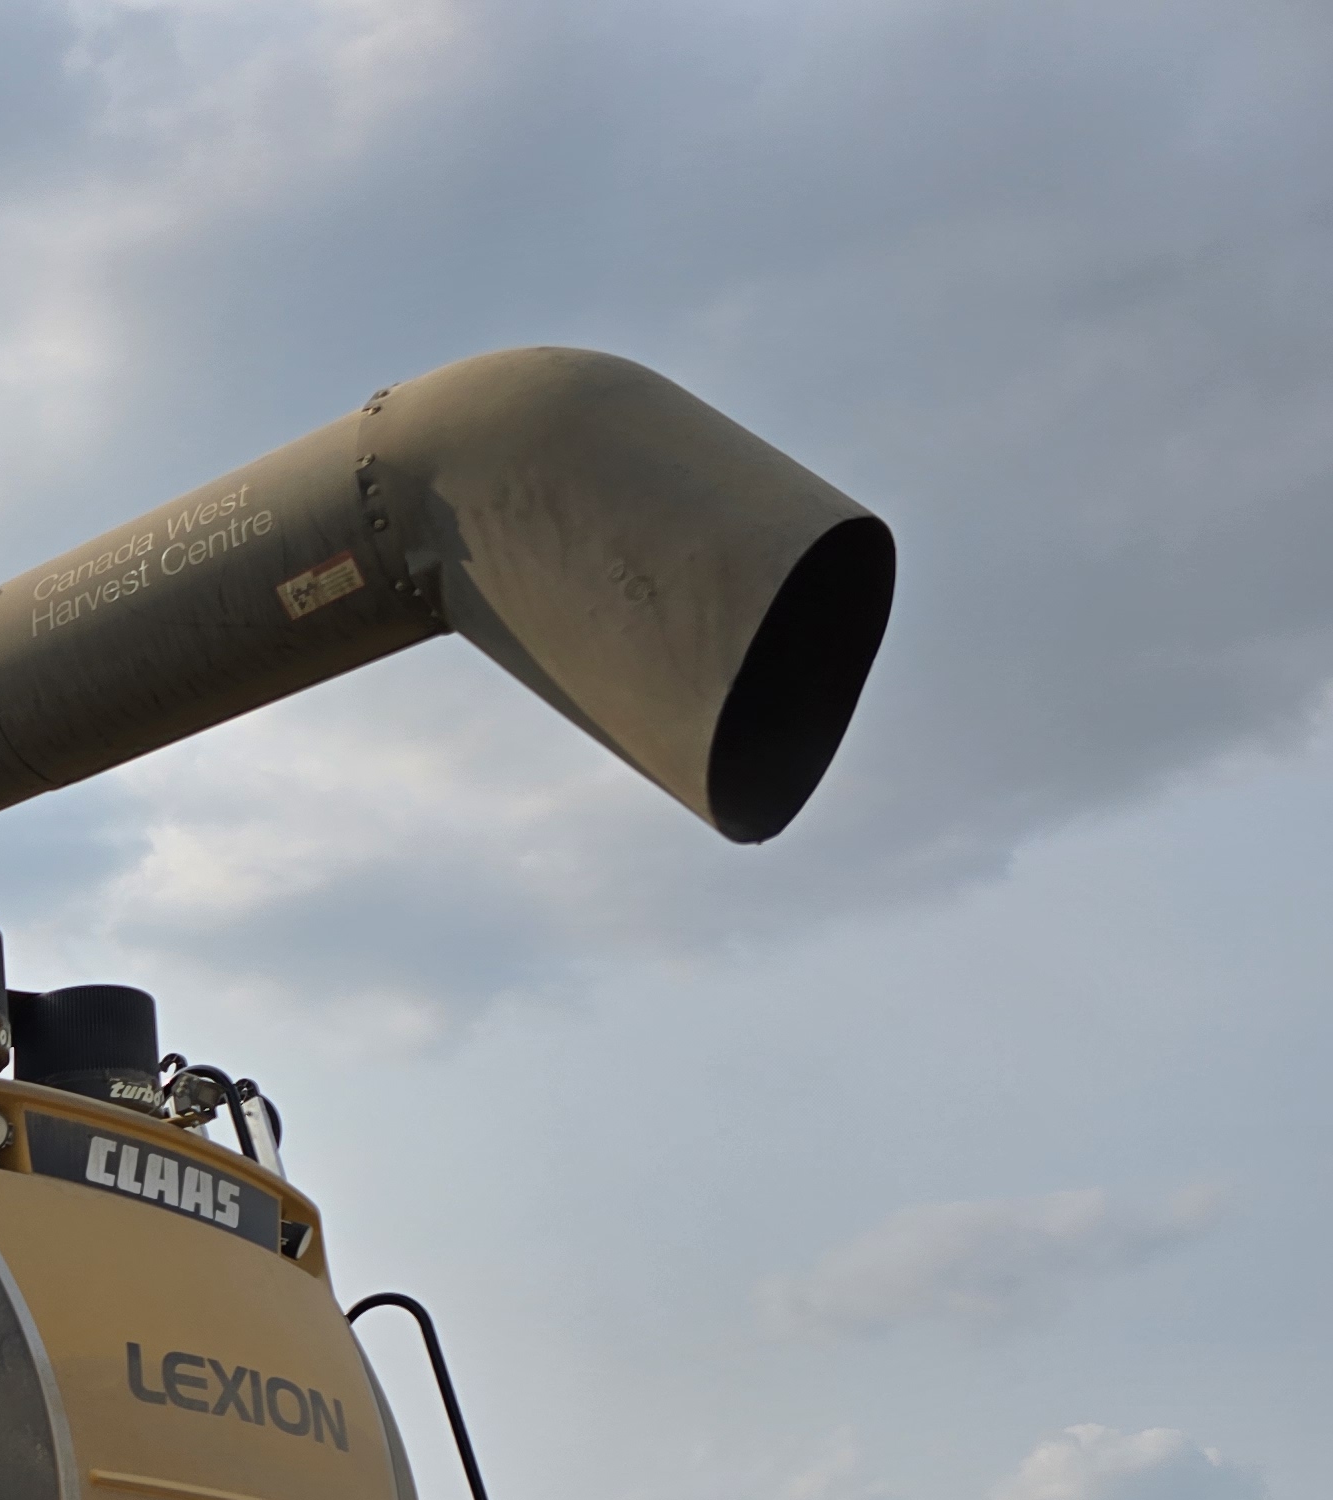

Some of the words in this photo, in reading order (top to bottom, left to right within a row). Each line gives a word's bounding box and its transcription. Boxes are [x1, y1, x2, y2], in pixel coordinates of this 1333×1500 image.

[32, 559, 151, 638] Harvest
[161, 509, 274, 576] Centre
[34, 532, 153, 601] Canada
[167, 484, 250, 541] West
[85, 1135, 241, 1229] CLAAS
[126, 1341, 350, 1453] LEXION
